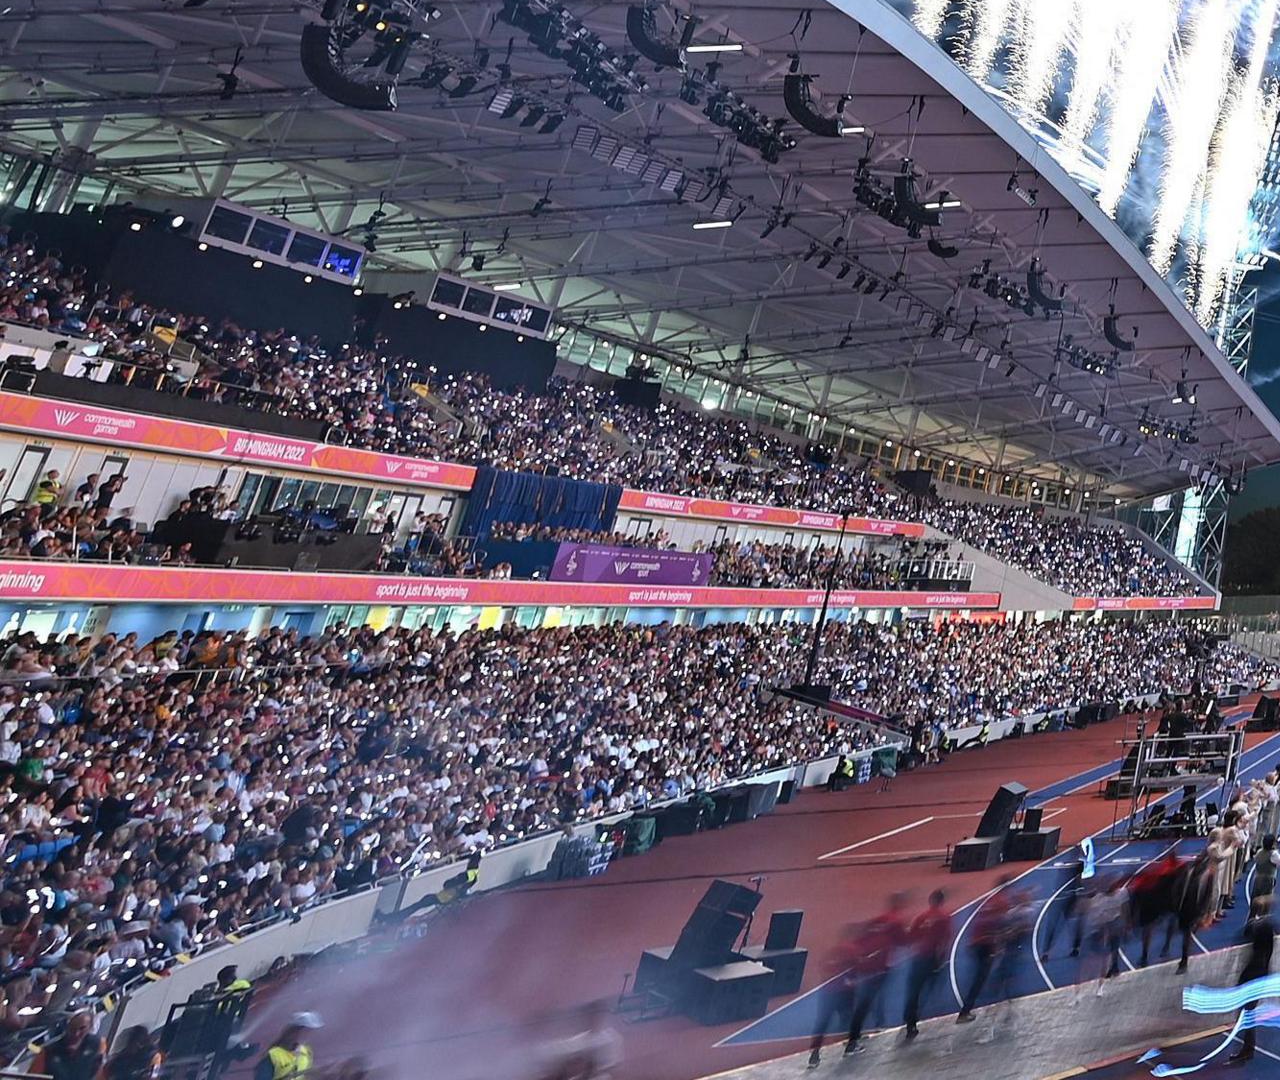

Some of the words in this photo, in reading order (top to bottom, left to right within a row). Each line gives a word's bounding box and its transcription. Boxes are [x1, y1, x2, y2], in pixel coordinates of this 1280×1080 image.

[84, 413, 136, 429] commonwealth
[93, 424, 119, 436] games
[283, 445, 305, 461] 2022
[376, 583, 400, 598] sport
[404, 583, 421, 599] just
[421, 584, 435, 597] the
[434, 584, 469, 600] beginning
